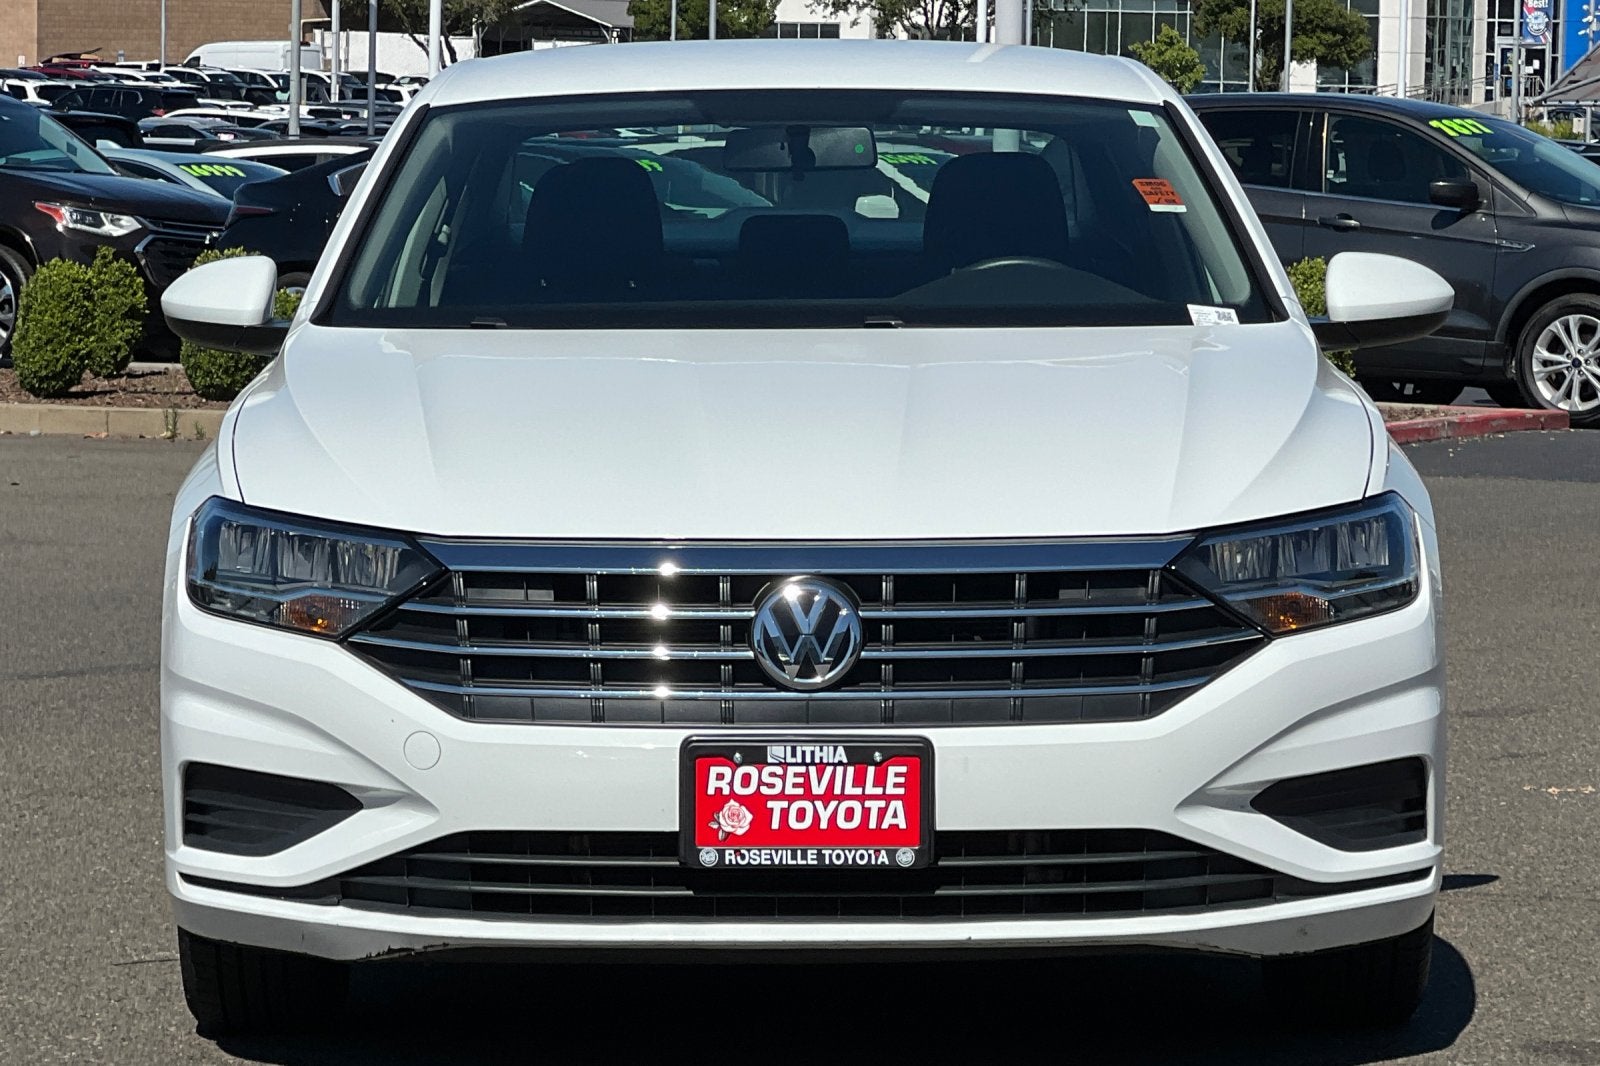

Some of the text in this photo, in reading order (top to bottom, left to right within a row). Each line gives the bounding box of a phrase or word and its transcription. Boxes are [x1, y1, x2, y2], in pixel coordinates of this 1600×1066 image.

[785, 746, 848, 763] LITHIA
[706, 765, 908, 796] ROSEVILLE
[766, 800, 908, 830] TOYOTA
[724, 849, 818, 865] ROSEVILLE
[821, 849, 890, 865] TOYOTA
